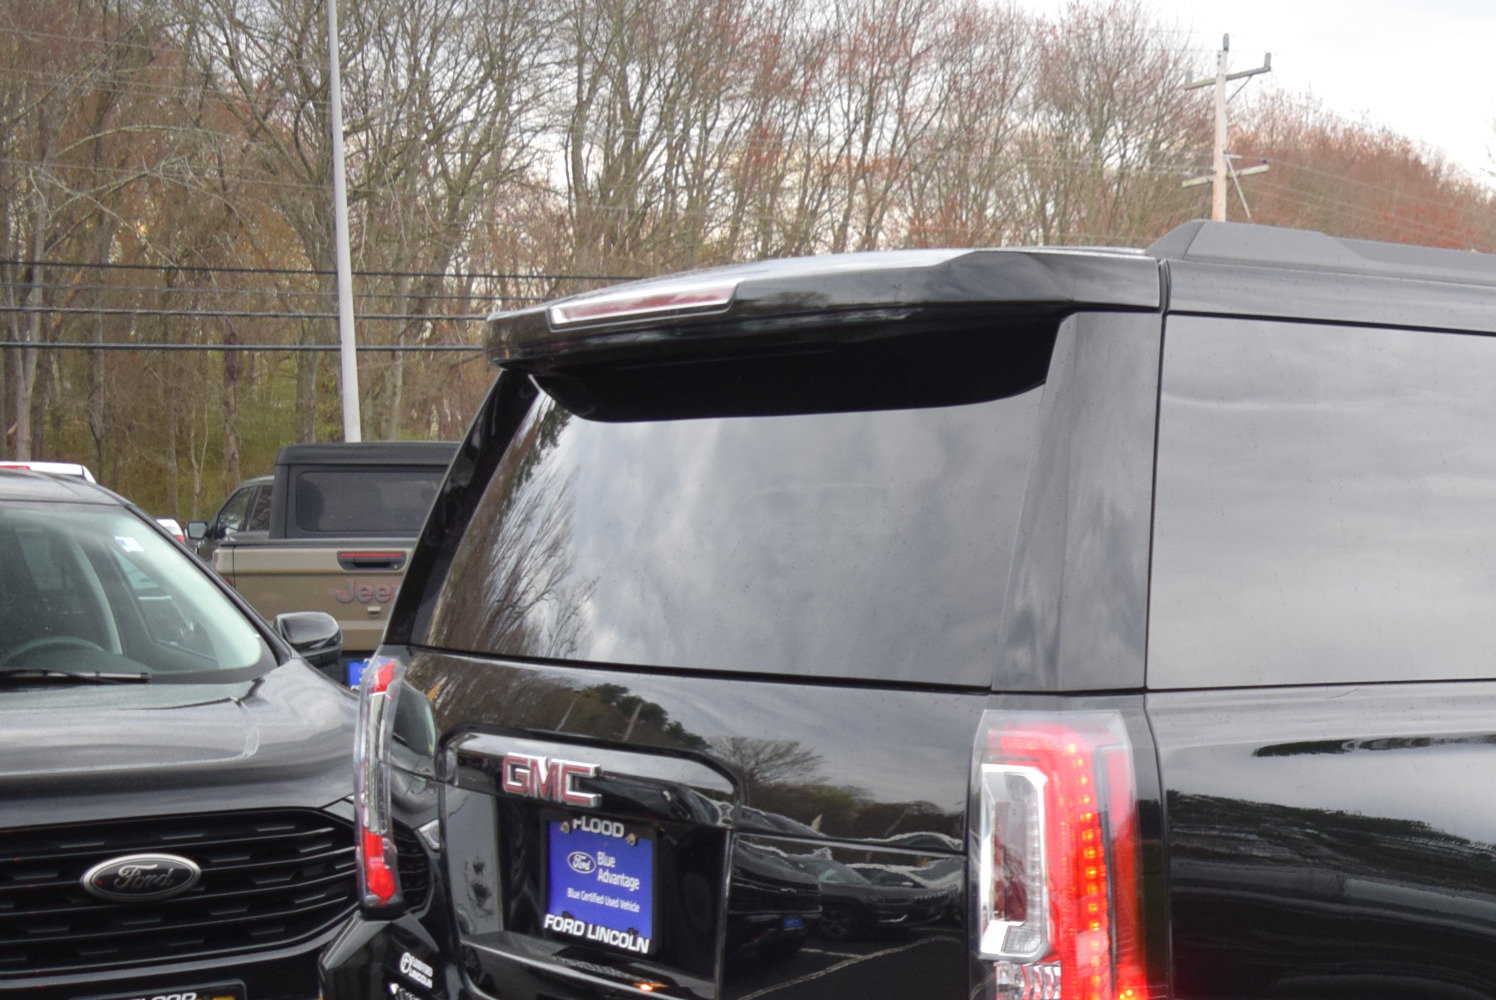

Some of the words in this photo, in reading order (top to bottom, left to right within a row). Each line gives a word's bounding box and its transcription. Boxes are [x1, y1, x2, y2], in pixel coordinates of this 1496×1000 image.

[502, 752, 602, 808] GMC
[572, 853, 592, 871] Ford
[597, 851, 616, 868] Blue
[597, 868, 640, 892] Advantage
[567, 887, 580, 900] Blue
[580, 890, 605, 905] Certified
[604, 895, 620, 908] Used
[620, 899, 640, 913] Vehicle
[543, 913, 586, 937] FORD
[586, 926, 650, 954] LINCOLN
